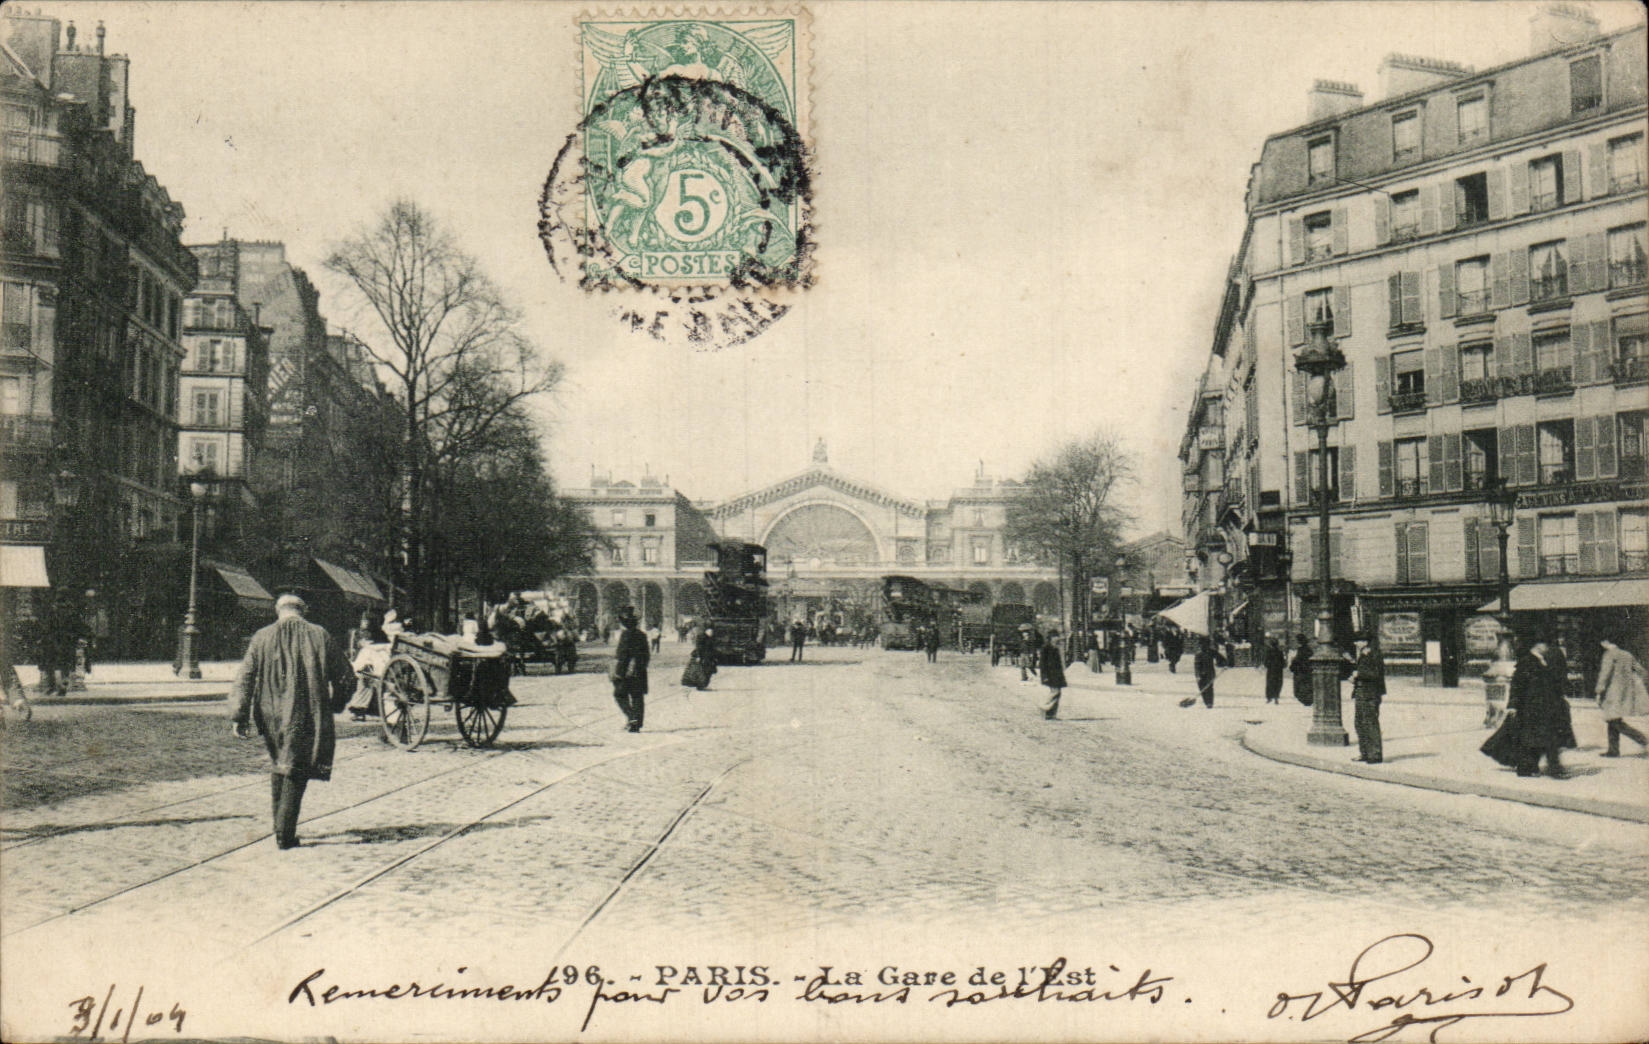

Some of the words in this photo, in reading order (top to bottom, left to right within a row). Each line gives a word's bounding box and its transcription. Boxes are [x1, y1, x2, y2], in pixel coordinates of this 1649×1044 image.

[645, 254, 736, 275] POSTES
[580, 978, 681, 1032] pour
[795, 974, 912, 1005] bons
